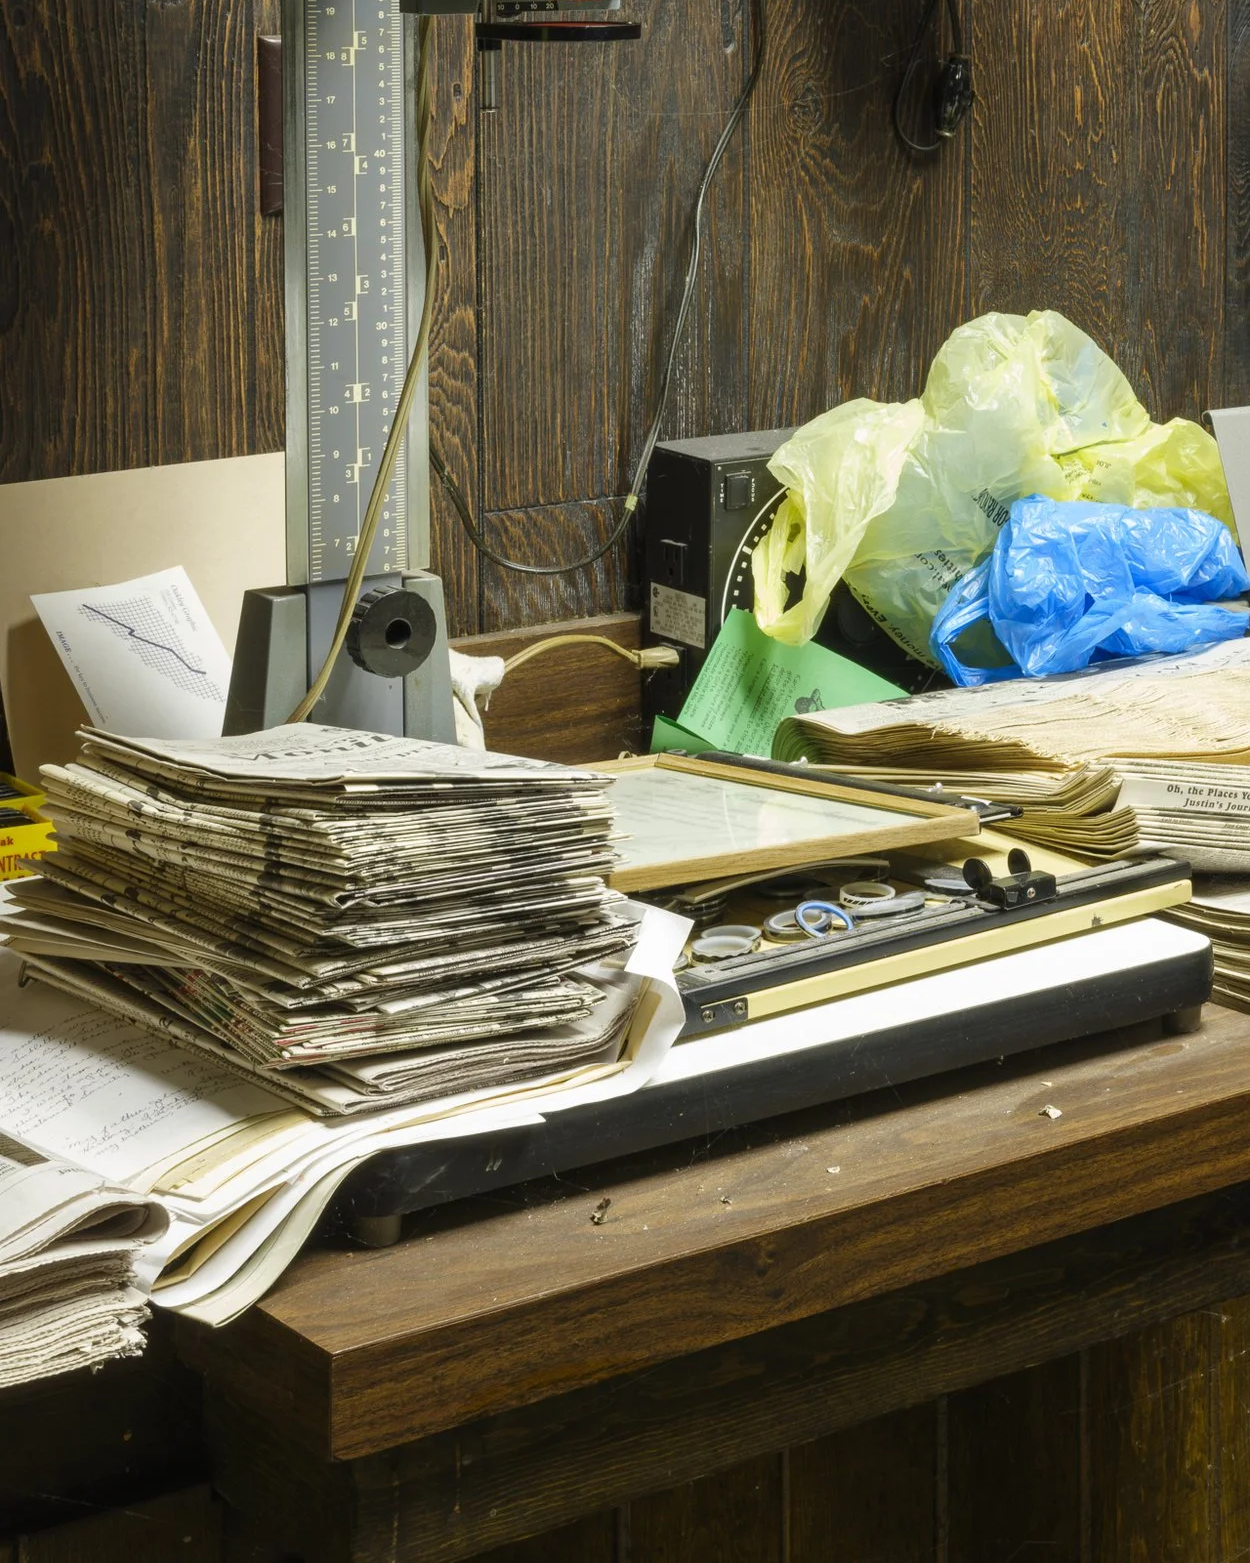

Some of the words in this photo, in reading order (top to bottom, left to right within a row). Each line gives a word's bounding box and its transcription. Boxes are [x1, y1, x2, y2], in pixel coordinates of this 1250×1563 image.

[378, 11, 384, 19] 8
[379, 28, 384, 36] 7
[326, 52, 335, 60] 18
[378, 80, 384, 88] 4
[326, 141, 336, 149] 16
[380, 184, 385, 192] 8
[380, 202, 386, 210] 7
[343, 223, 348, 231] 6
[380, 236, 386, 244] 5
[380, 253, 386, 261] 4
[328, 274, 338, 282] 13
[381, 270, 386, 278] 3
[364, 280, 369, 288] 3
[328, 318, 338, 326] 12
[376, 322, 387, 330] 30
[382, 339, 387, 347] 9
[382, 356, 388, 364] 8
[331, 362, 338, 370] 11
[365, 388, 370, 396] 2
[329, 406, 339, 414] 10
[382, 408, 388, 416] 5
[382, 425, 388, 433] 4
[346, 470, 351, 478] 3
[384, 529, 389, 537] 8
[334, 539, 340, 547] 7
[384, 546, 389, 554] 7
[384, 563, 389, 571] 6
[1166, 784, 1184, 796] Oh,
[1188, 786, 1205, 796] the
[1207, 788, 1238, 799] Places
[1183, 798, 1223, 811] Justin's
